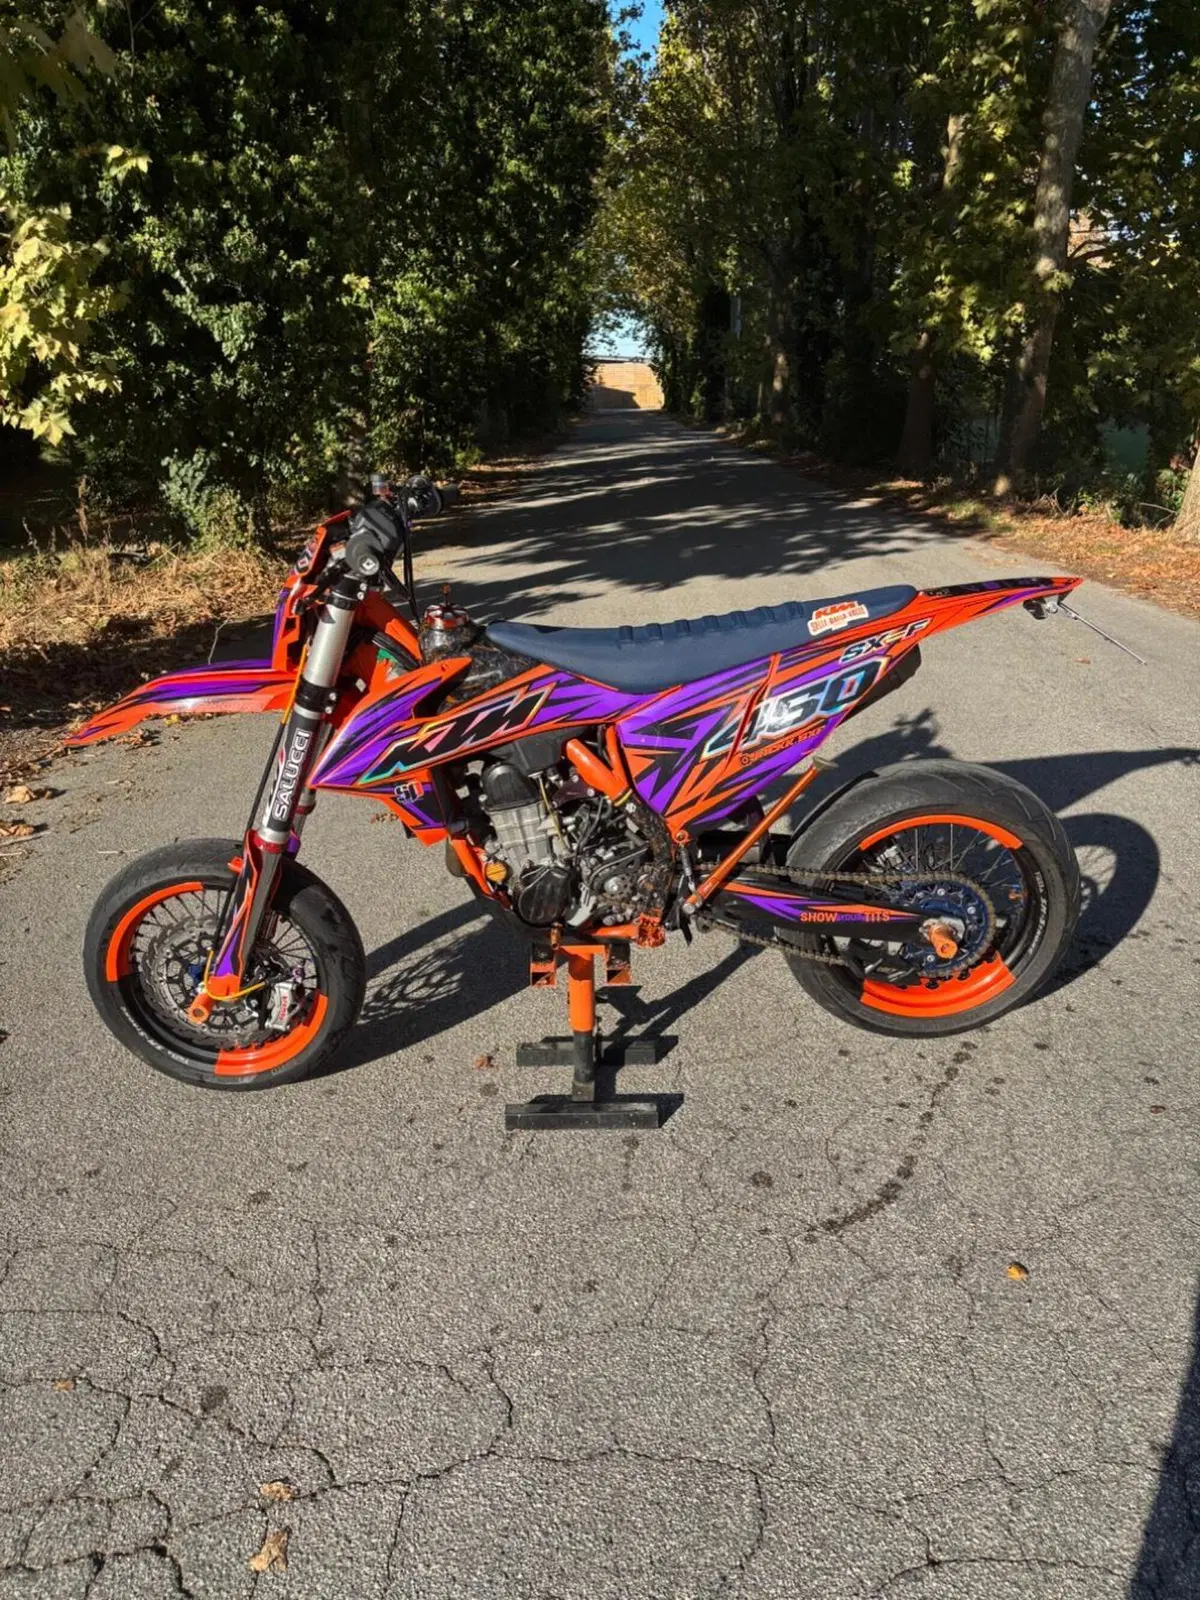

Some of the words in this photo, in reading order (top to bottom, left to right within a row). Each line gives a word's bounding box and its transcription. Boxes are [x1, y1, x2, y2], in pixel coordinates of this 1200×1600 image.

[814, 601, 857, 619] KTM
[361, 683, 556, 785] KTM
[701, 655, 890, 759] 450
[273, 730, 311, 820] SALUCCI
[800, 911, 839, 923] SHOW
[864, 910, 891, 923] TITS
